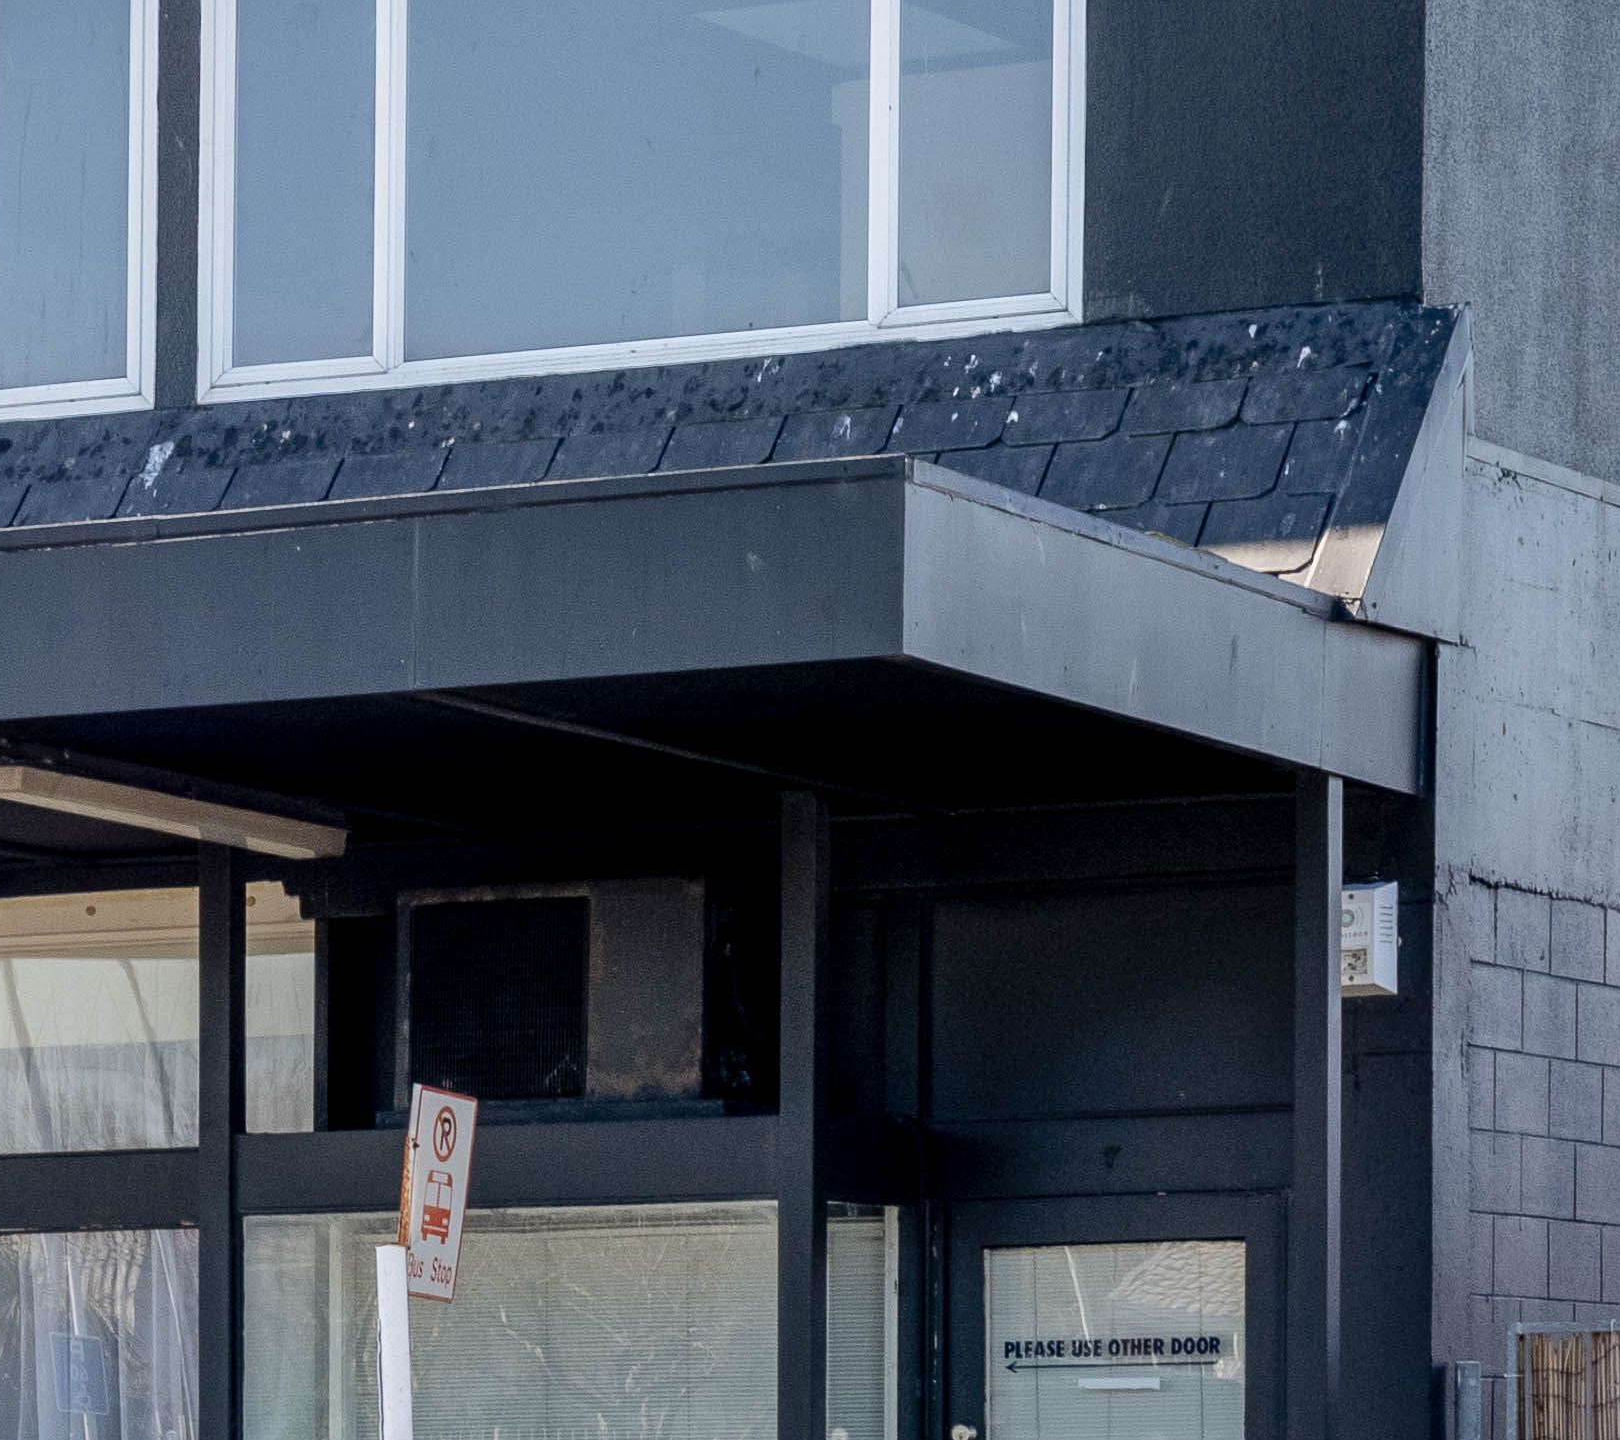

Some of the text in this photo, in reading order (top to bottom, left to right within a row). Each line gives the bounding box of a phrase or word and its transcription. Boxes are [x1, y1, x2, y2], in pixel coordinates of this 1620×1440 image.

[430, 1256, 453, 1289] Stop
[1004, 1336, 1221, 1359] PLEASE USE OTHER DOOR
